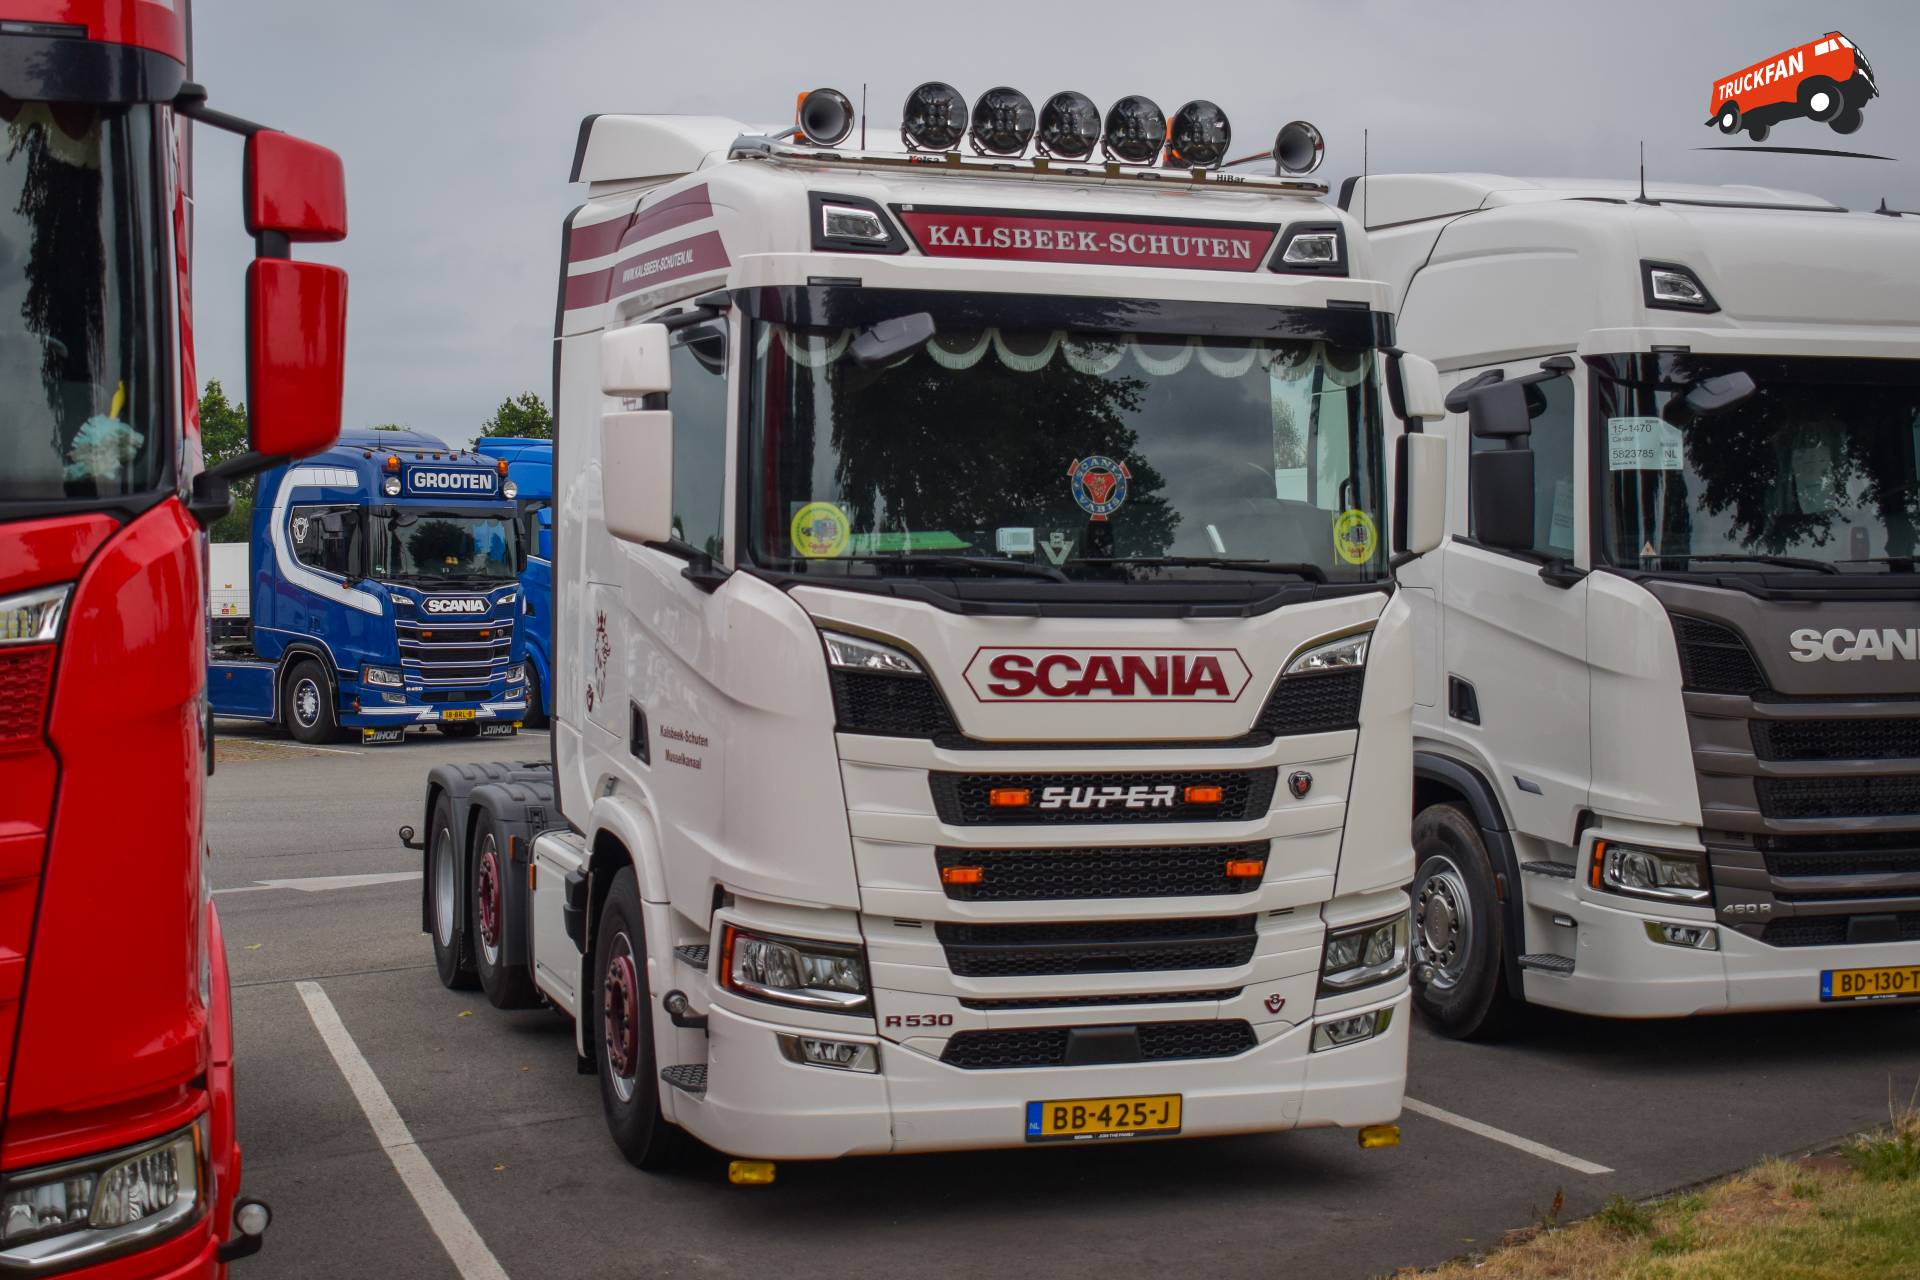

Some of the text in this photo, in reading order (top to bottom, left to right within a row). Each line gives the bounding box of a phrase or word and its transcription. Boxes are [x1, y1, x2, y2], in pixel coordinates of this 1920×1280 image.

[1216, 174, 1246, 184] HiBar
[927, 225, 1252, 260] KALSBEEK-SCHUTEN
[1613, 423, 1652, 434] 15-1470
[1612, 449, 1678, 459] 5823785 NL
[414, 472, 492, 490] GROOTEN
[427, 599, 486, 613] SCANIA
[1788, 628, 1920, 662] SCAN
[986, 654, 1230, 698] SCANIA
[1039, 785, 1177, 809] SUPER
[1841, 970, 1920, 993] BD-130-T
[885, 1013, 954, 1028] R 530
[1052, 1101, 1170, 1130] BB-425-J
[1029, 1121, 1041, 1130] NL
